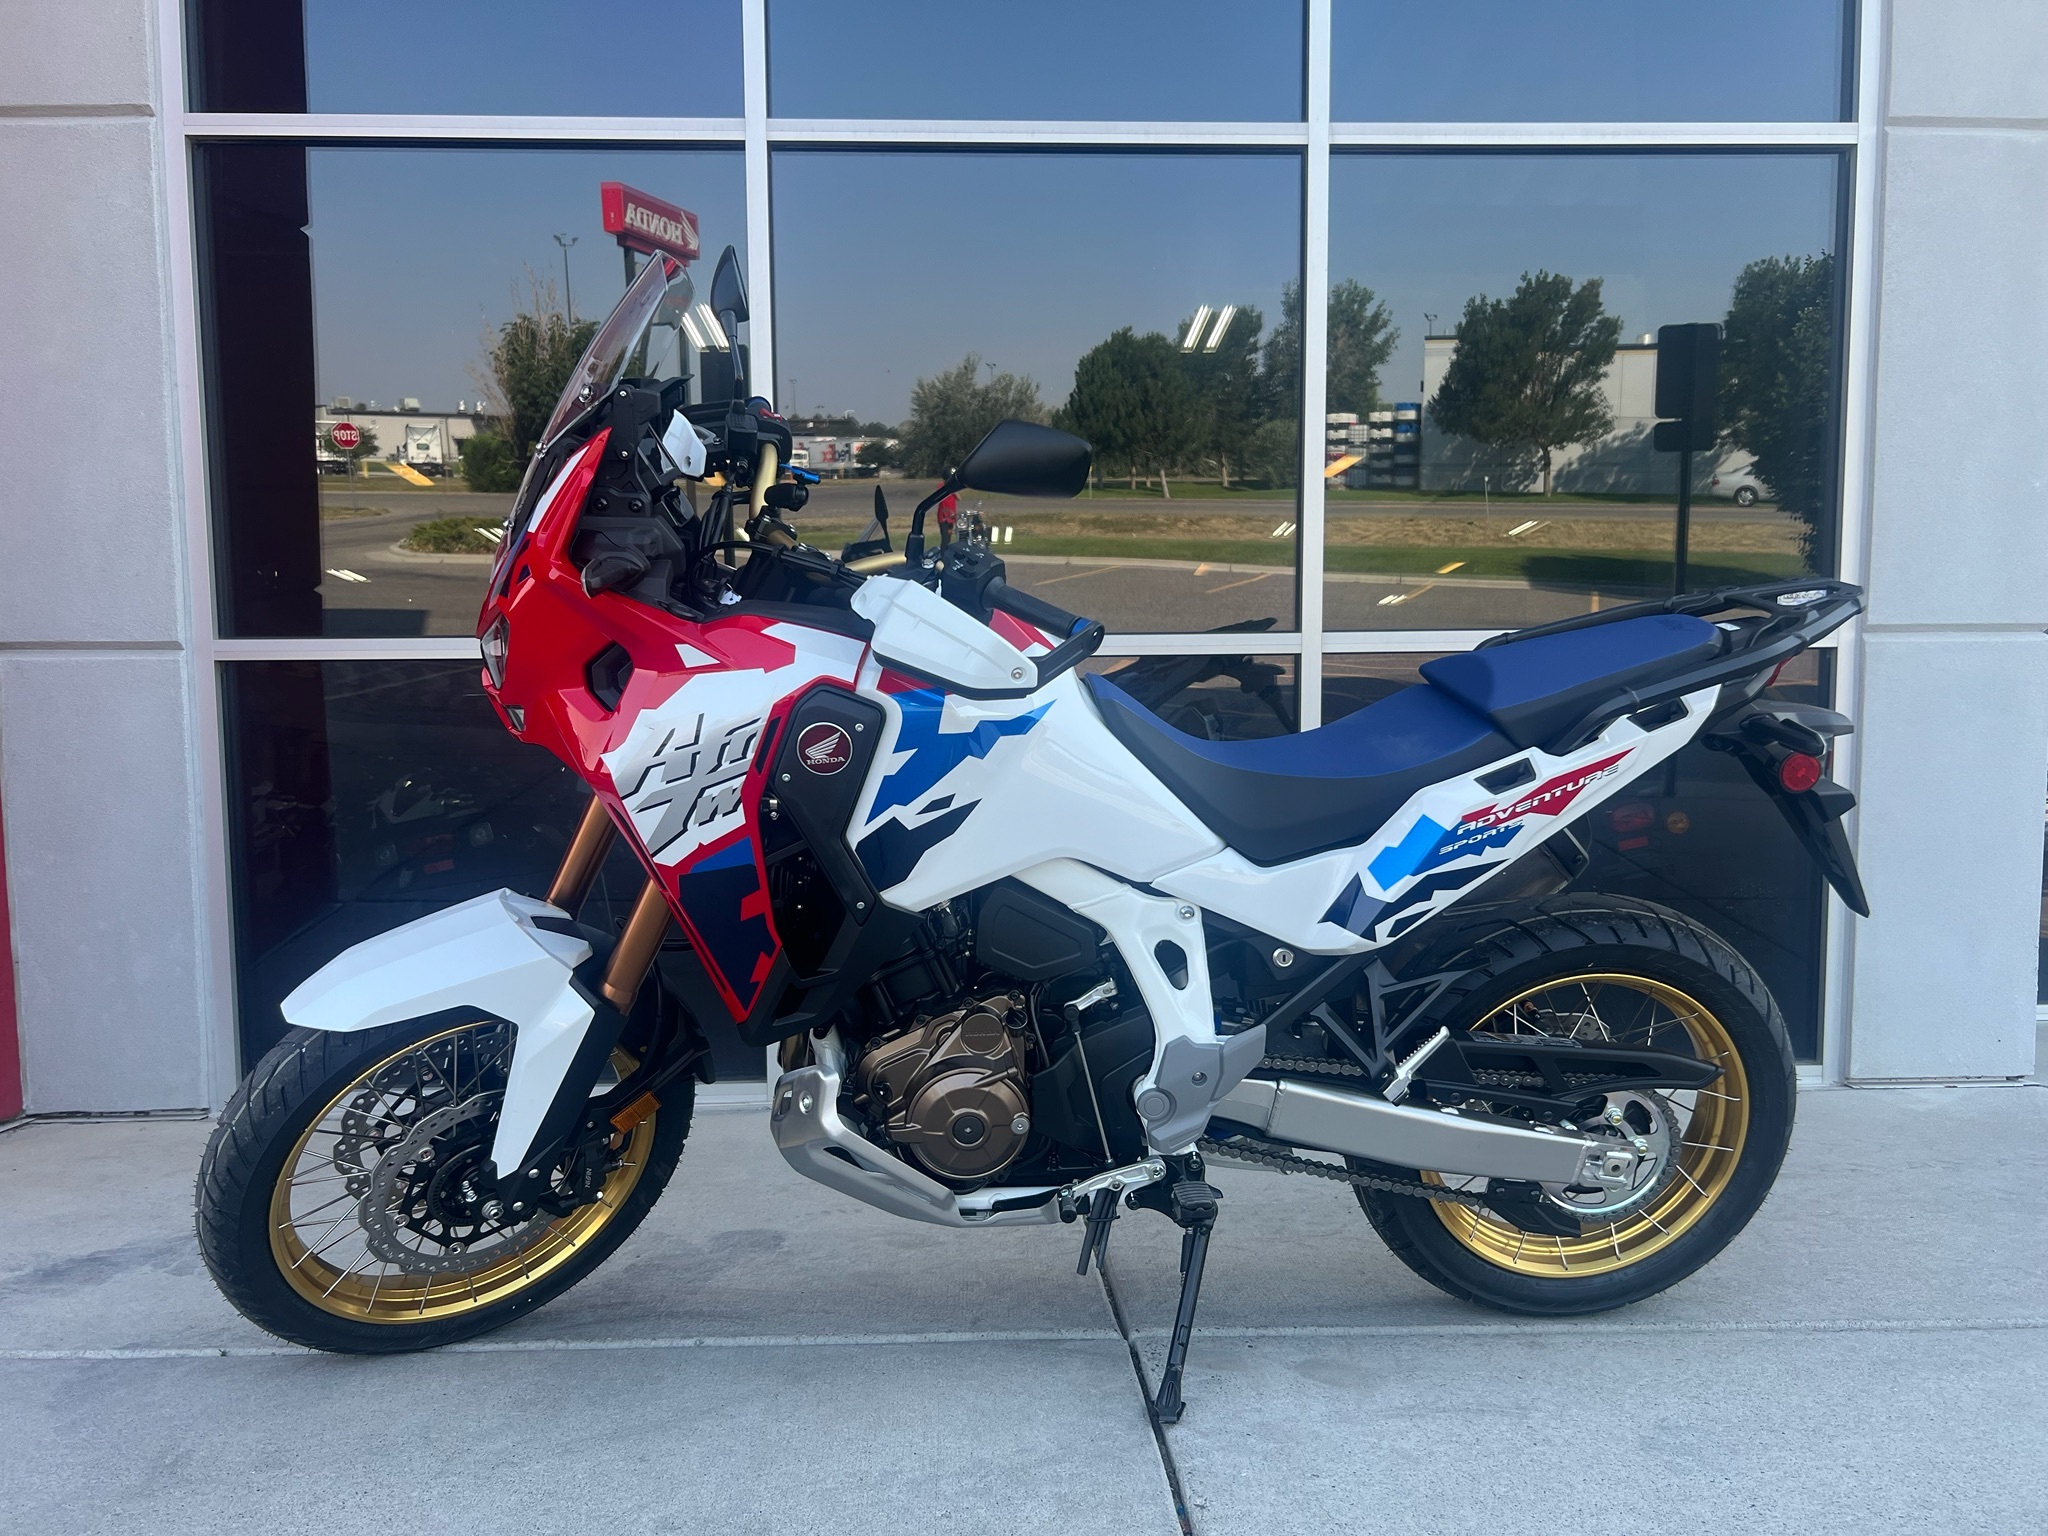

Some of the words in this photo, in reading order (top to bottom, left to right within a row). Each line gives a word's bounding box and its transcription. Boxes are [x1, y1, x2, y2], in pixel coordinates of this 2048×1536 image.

[806, 757, 846, 765] HONDA
[1456, 764, 1619, 835] ADVENTURE
[1439, 819, 1524, 855] SPORTS
